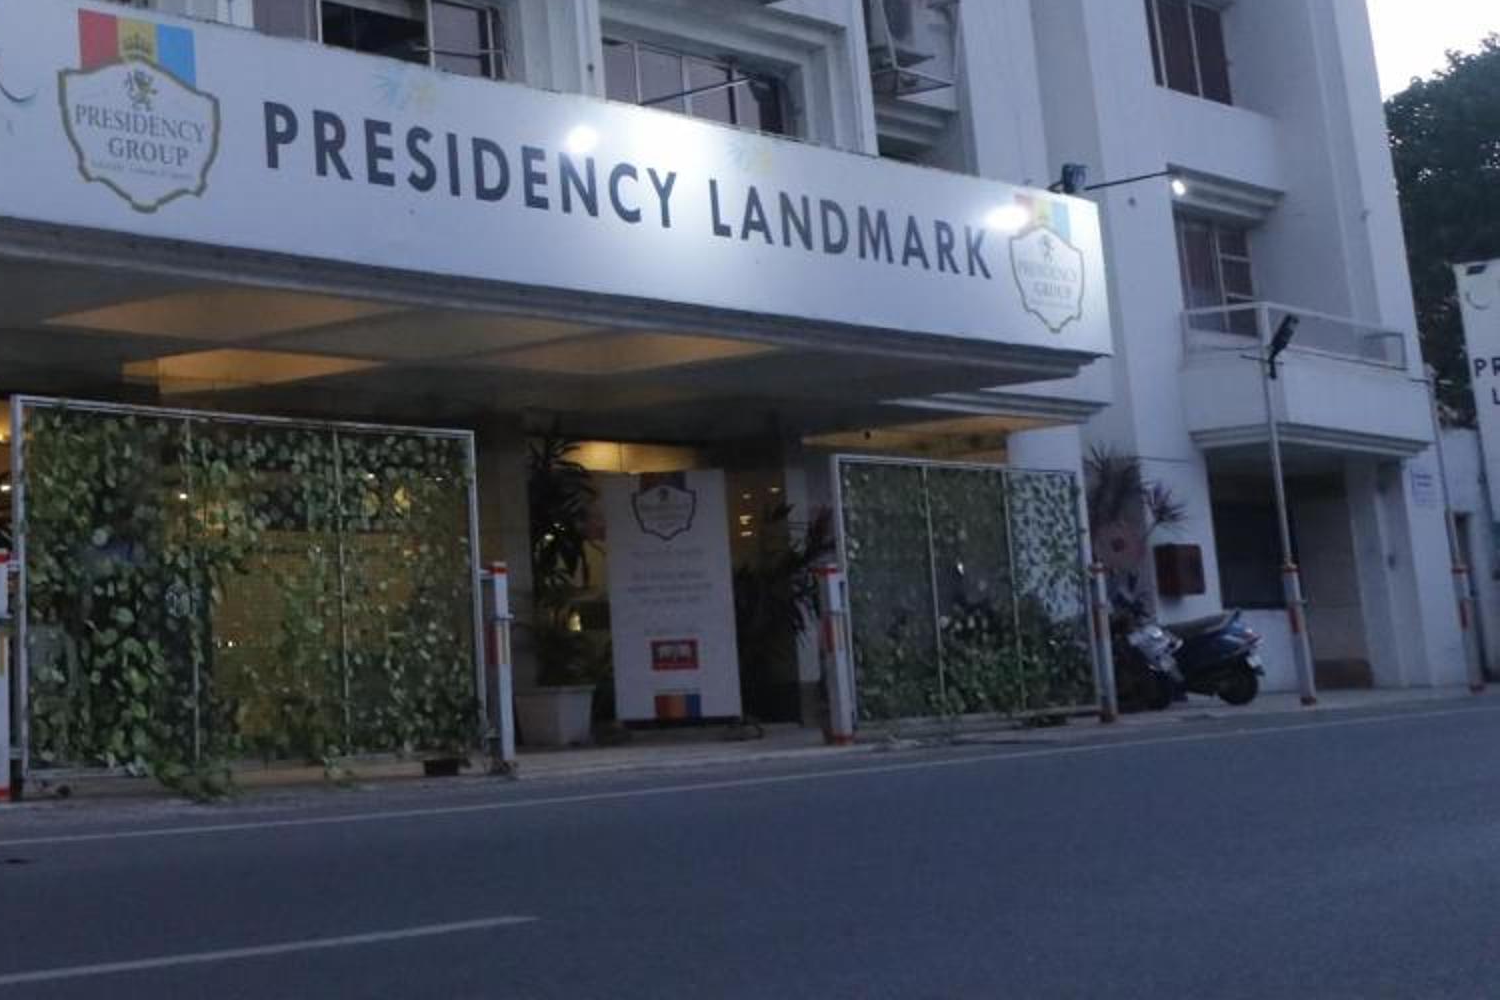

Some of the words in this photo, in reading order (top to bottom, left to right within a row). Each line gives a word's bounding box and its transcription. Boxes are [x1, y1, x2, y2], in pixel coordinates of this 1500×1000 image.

[74, 103, 206, 144] PRESIDENCY
[107, 136, 190, 168] GROUP
[263, 101, 677, 228] PRESIDENCY
[709, 179, 992, 280] LANDMARK
